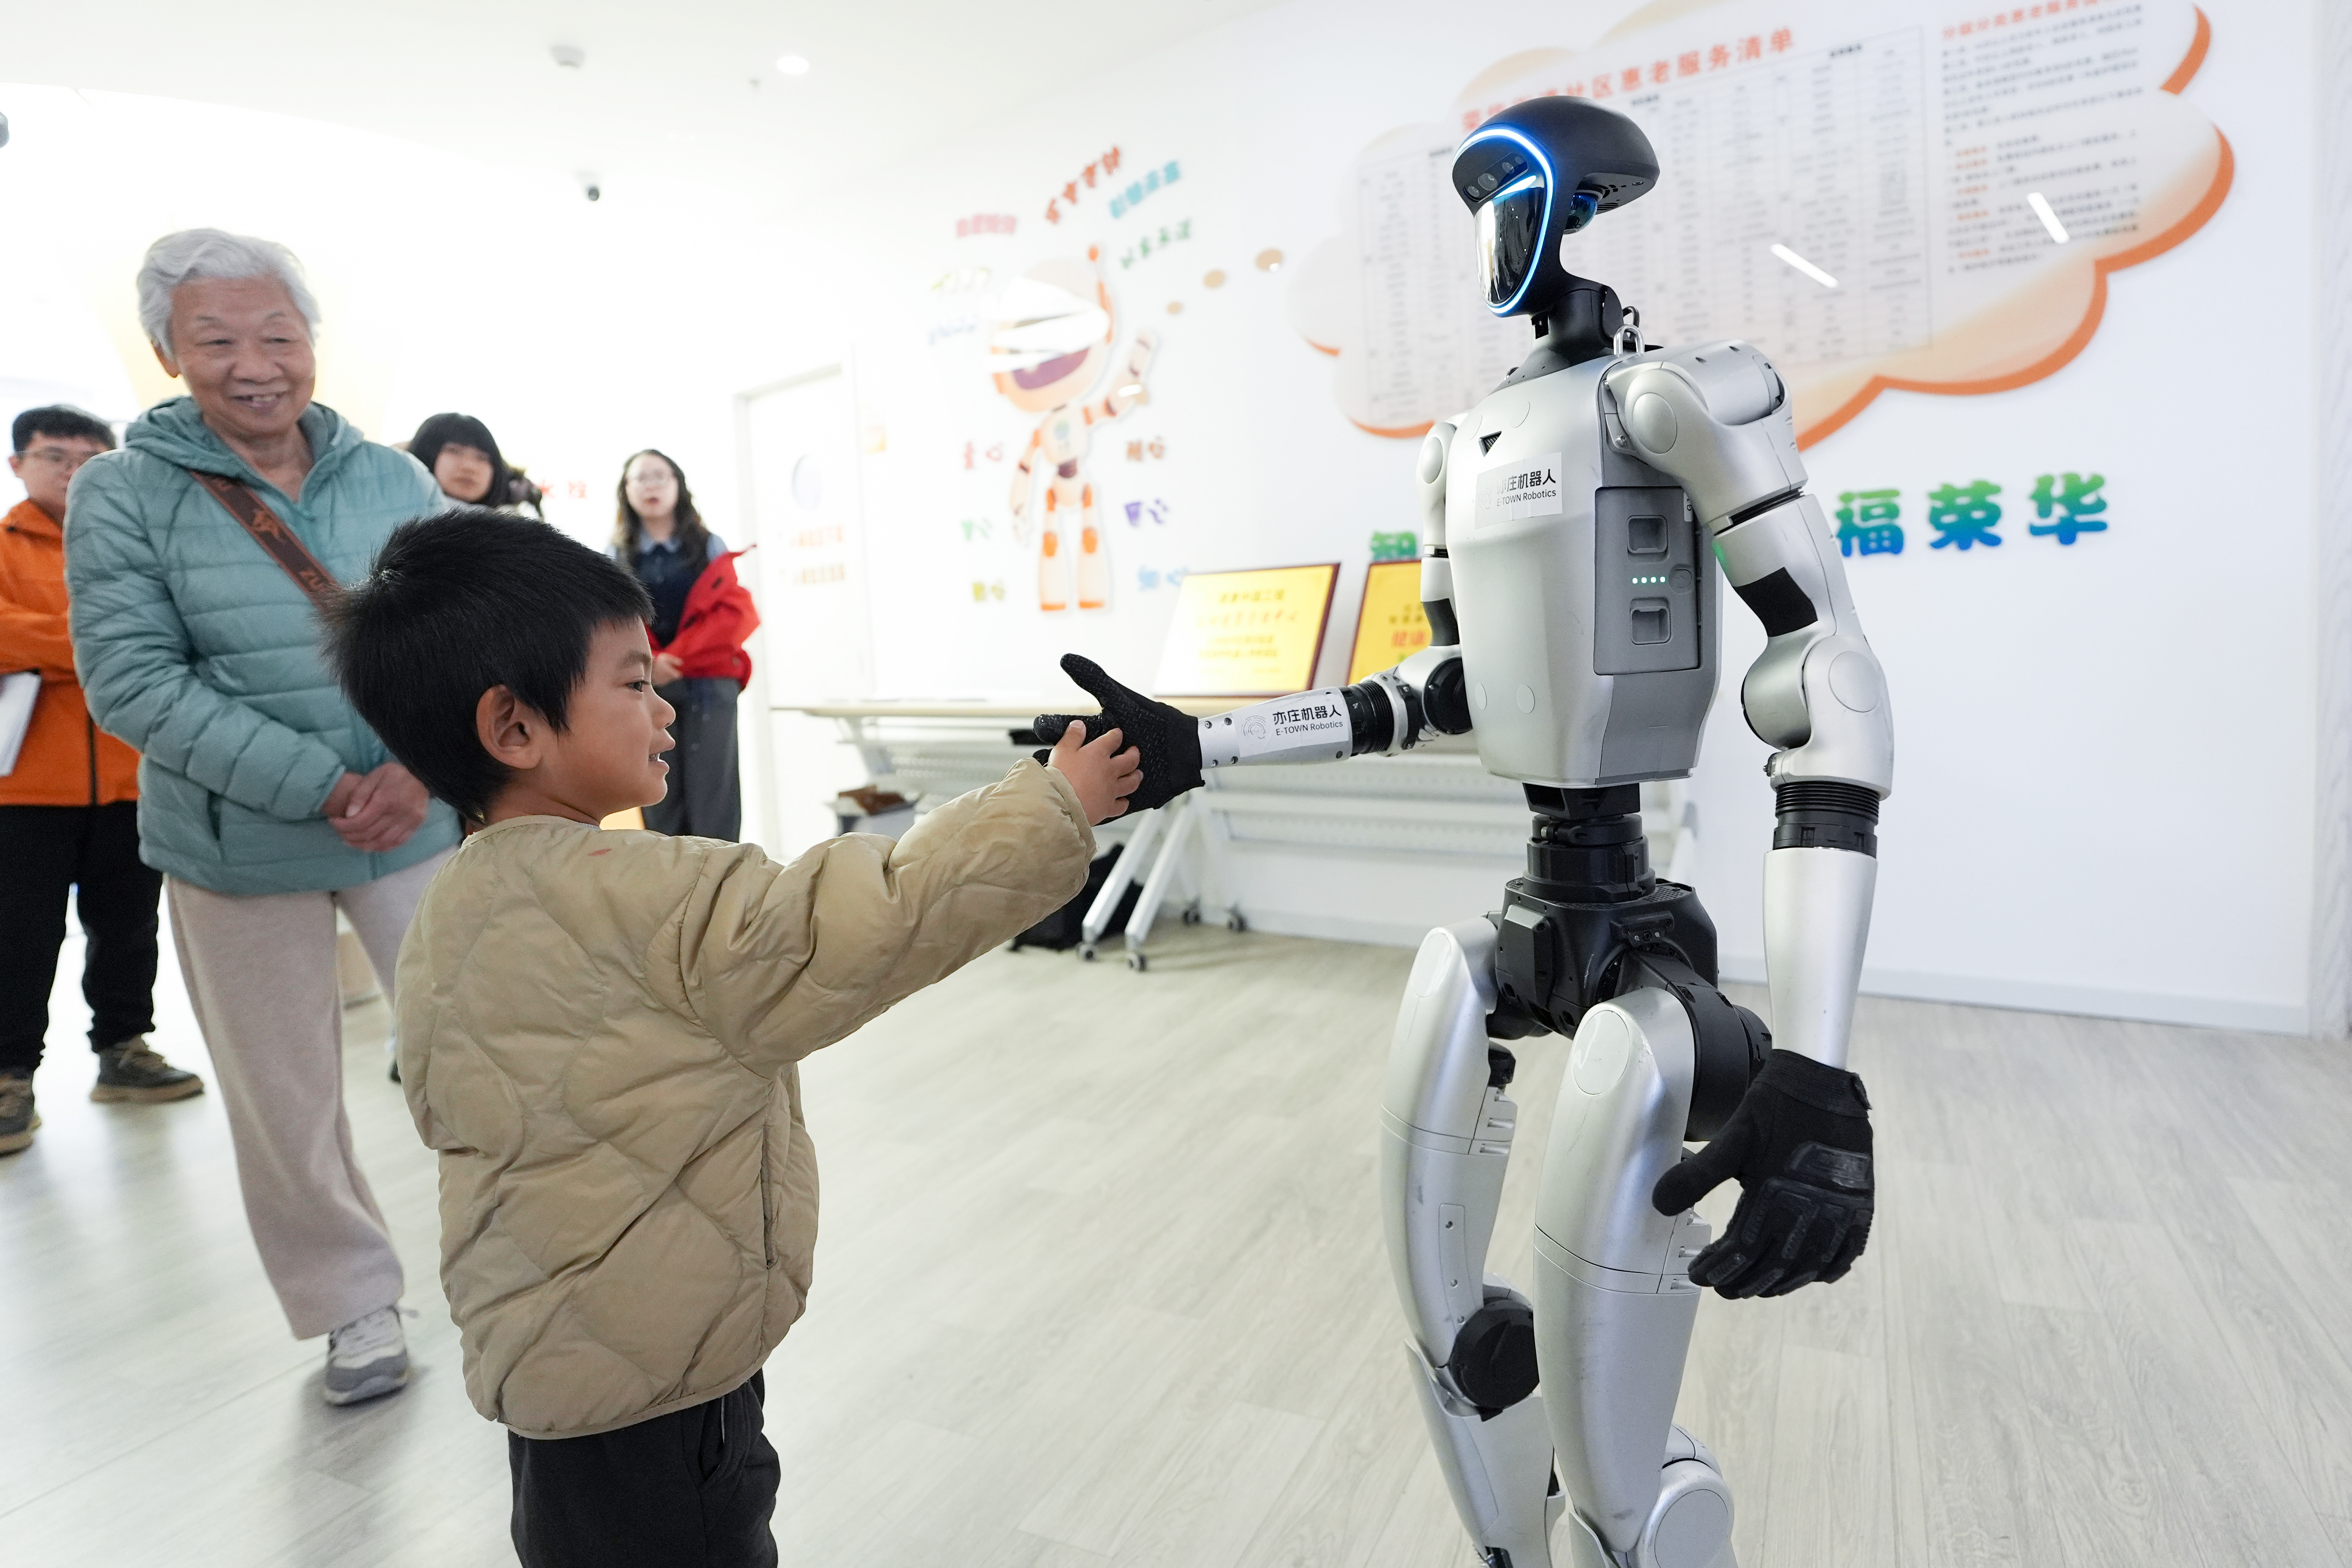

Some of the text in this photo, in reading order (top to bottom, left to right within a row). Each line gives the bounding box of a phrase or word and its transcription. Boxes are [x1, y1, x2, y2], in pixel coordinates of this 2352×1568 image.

[1497, 469, 1556, 495] 亦庄机器人
[1497, 489, 1556, 506] E-TOWN Robotics
[1835, 471, 2108, 556] 福荣华
[1272, 704, 1342, 725] 亦庄机器人
[1276, 721, 1343, 736] E-TOWN Robotics
